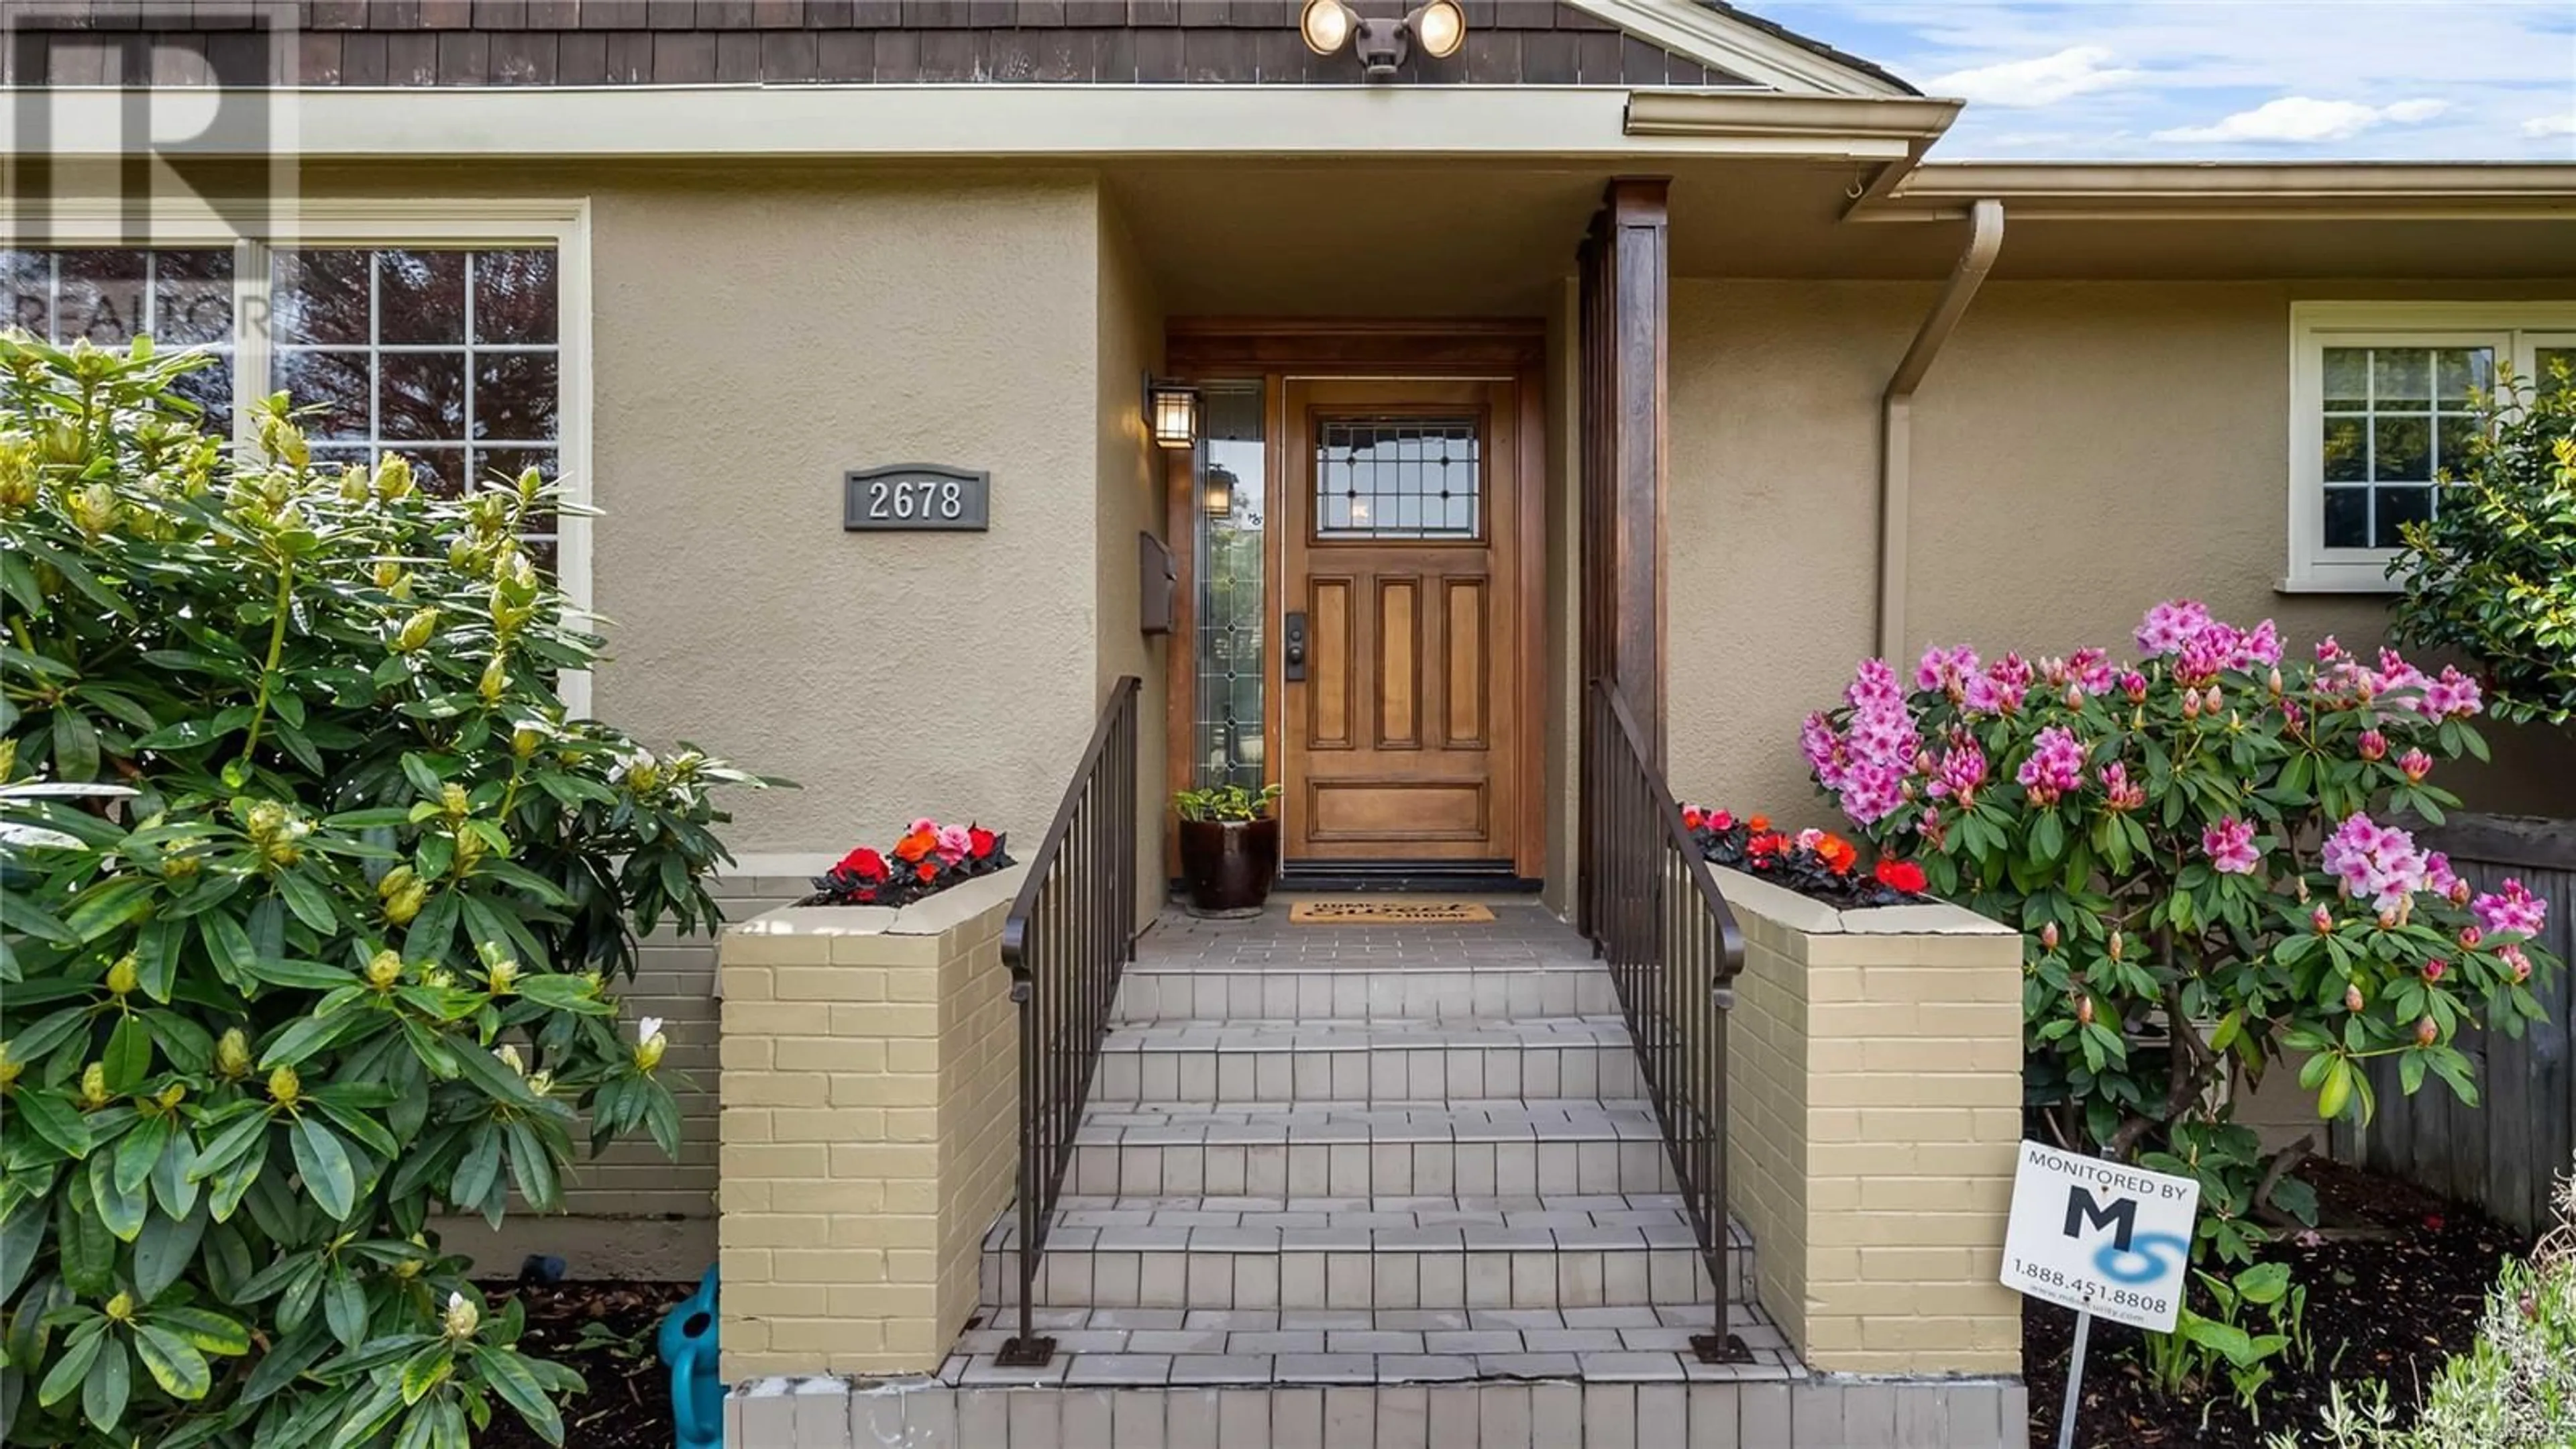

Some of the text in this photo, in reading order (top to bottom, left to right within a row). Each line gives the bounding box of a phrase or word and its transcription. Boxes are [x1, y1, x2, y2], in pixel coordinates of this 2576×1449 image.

[869, 482, 962, 519] 2678
[2028, 1150, 2188, 1201] MONITORED BY
[2013, 1258, 2167, 1313] 1.888.451.8808
